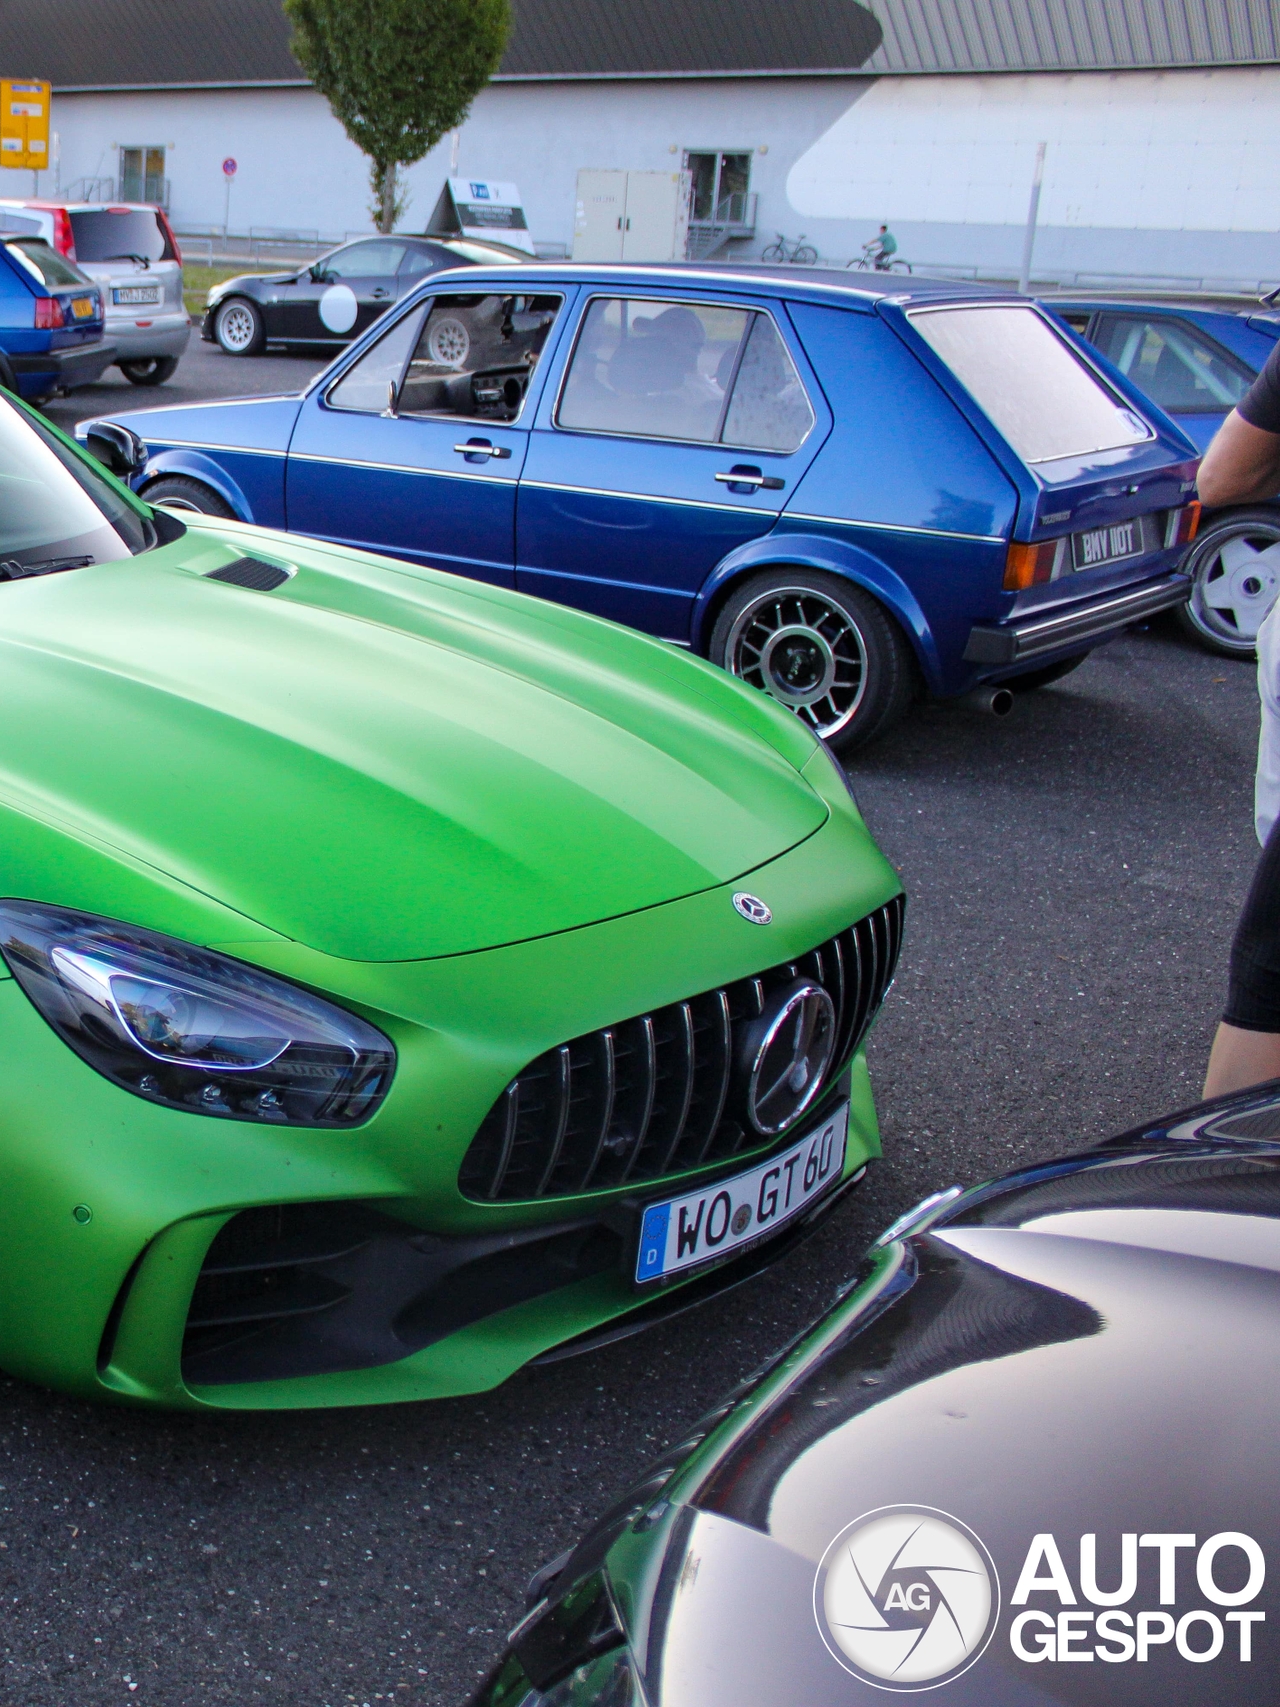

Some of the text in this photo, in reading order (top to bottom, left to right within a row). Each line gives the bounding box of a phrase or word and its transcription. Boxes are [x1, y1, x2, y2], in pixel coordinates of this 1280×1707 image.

[677, 1124, 834, 1259] WO GT 60
[646, 1248, 658, 1265] D
